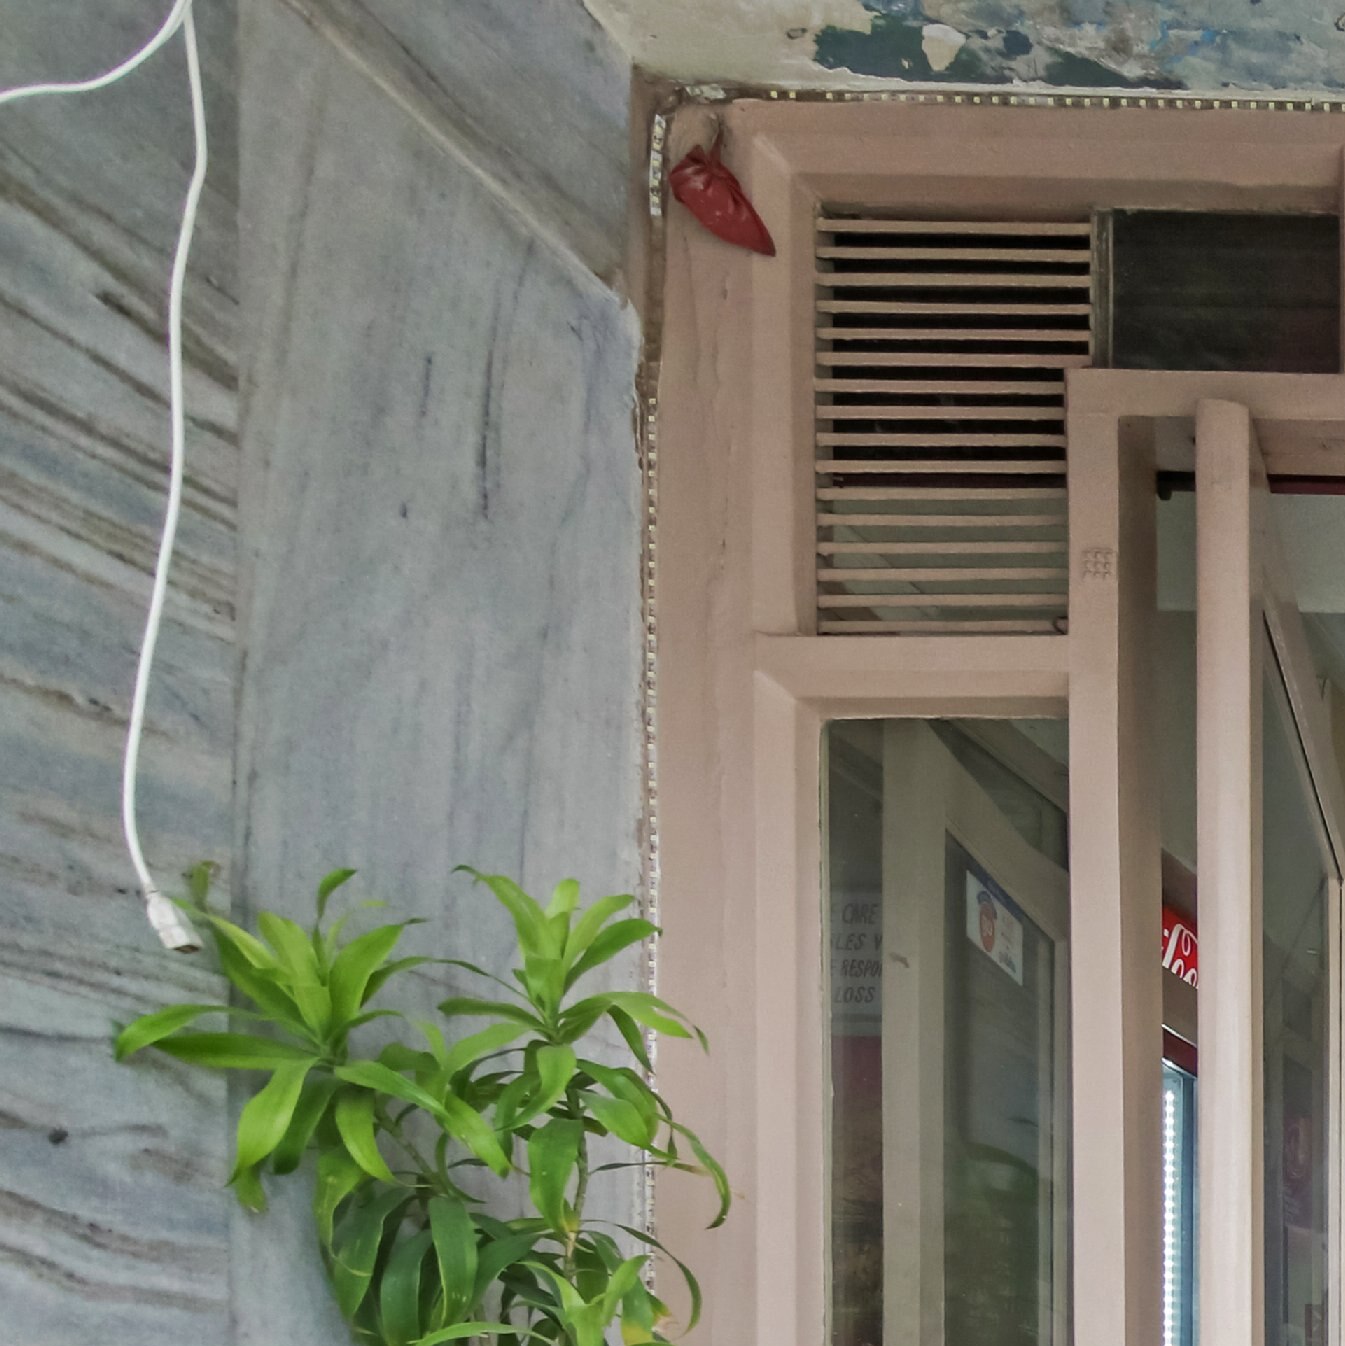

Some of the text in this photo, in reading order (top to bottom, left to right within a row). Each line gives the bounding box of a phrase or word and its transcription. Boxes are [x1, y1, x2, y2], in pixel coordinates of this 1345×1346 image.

[842, 902, 879, 925] CARE
[831, 932, 867, 951] LES
[834, 985, 876, 1004] LOSS
